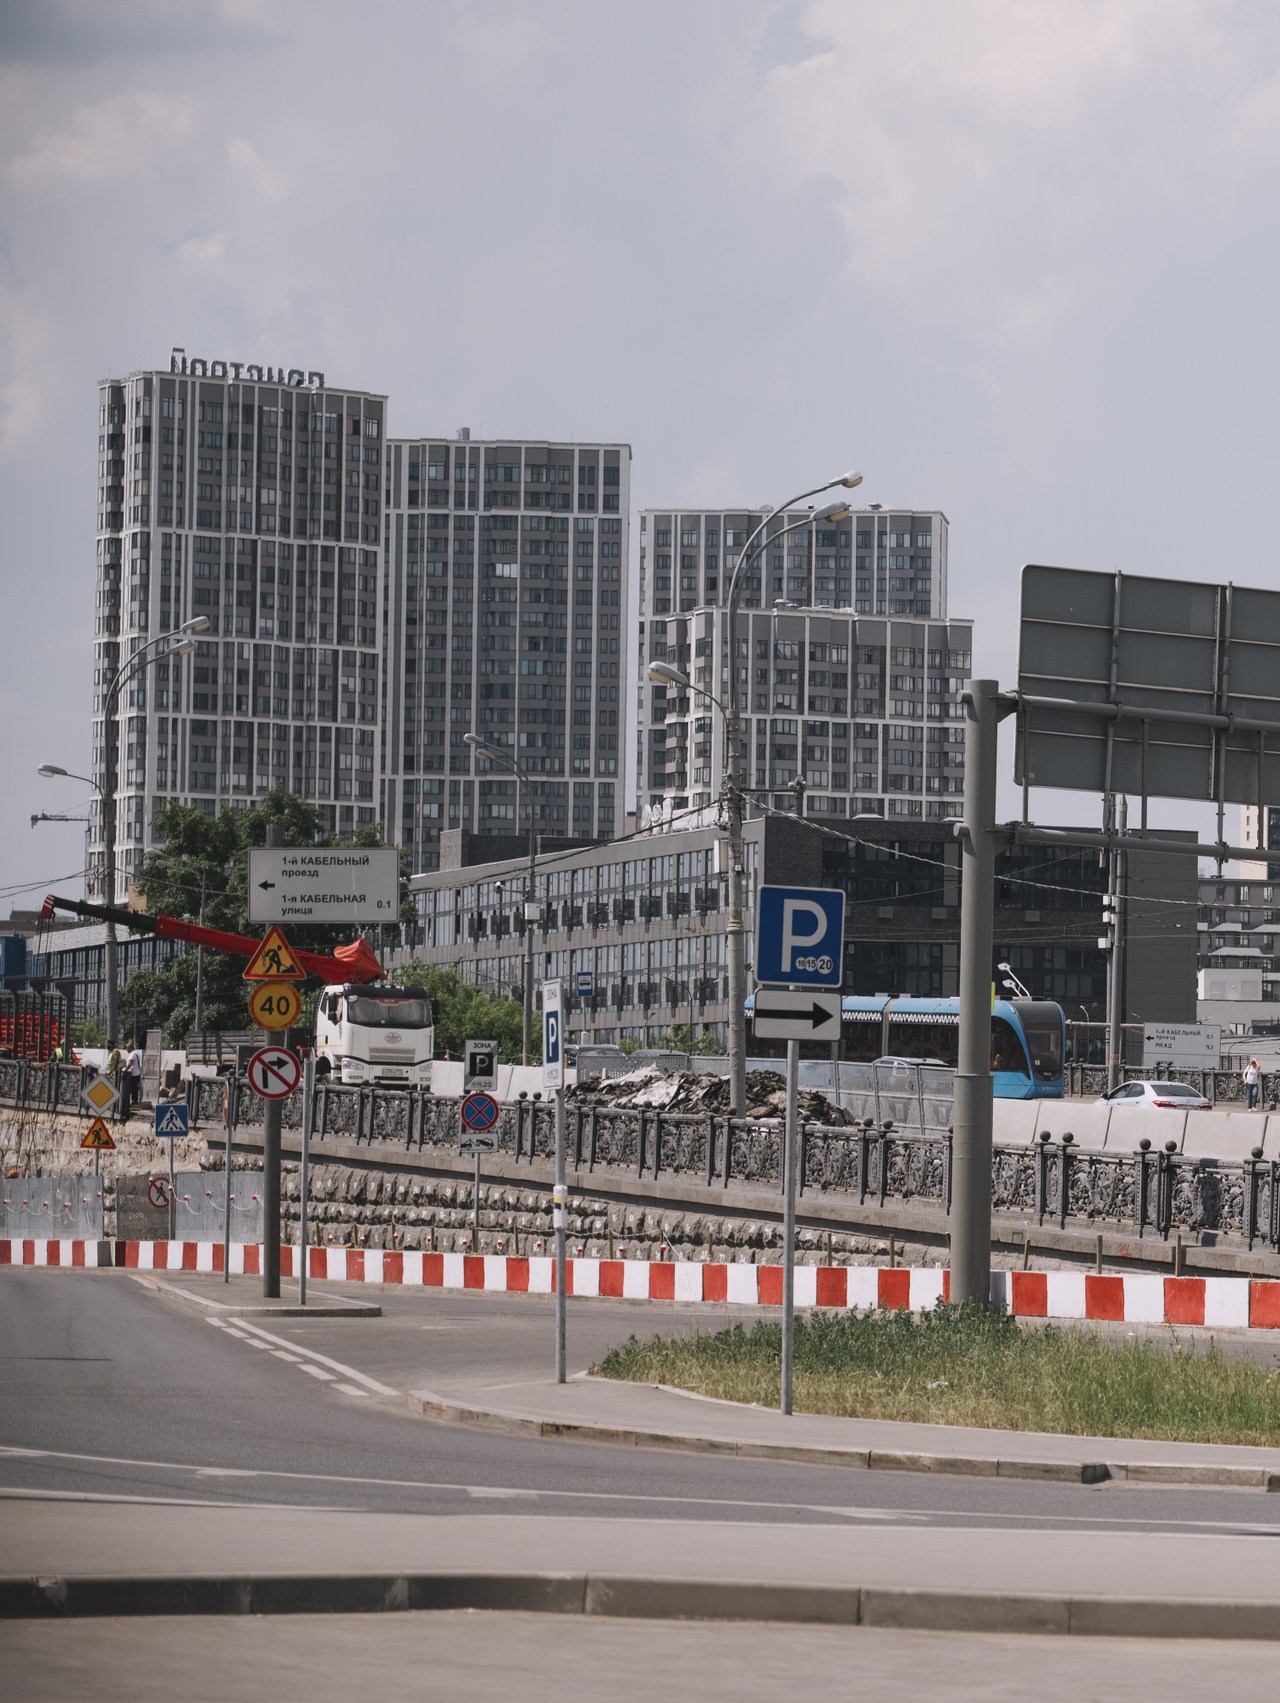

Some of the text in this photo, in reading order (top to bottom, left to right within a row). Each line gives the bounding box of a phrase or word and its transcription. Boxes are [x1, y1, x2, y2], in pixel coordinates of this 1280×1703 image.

[282, 856, 370, 866] 1-й КАБЕЛЬНЫЙ
[281, 869, 319, 878] проезд
[281, 894, 367, 904] 1-я КАБЕЛЬНАЯ
[281, 907, 313, 917] улица
[781, 898, 828, 973] P
[807, 959, 816, 970] 15
[818, 959, 832, 970] 20
[260, 995, 290, 1016] 40
